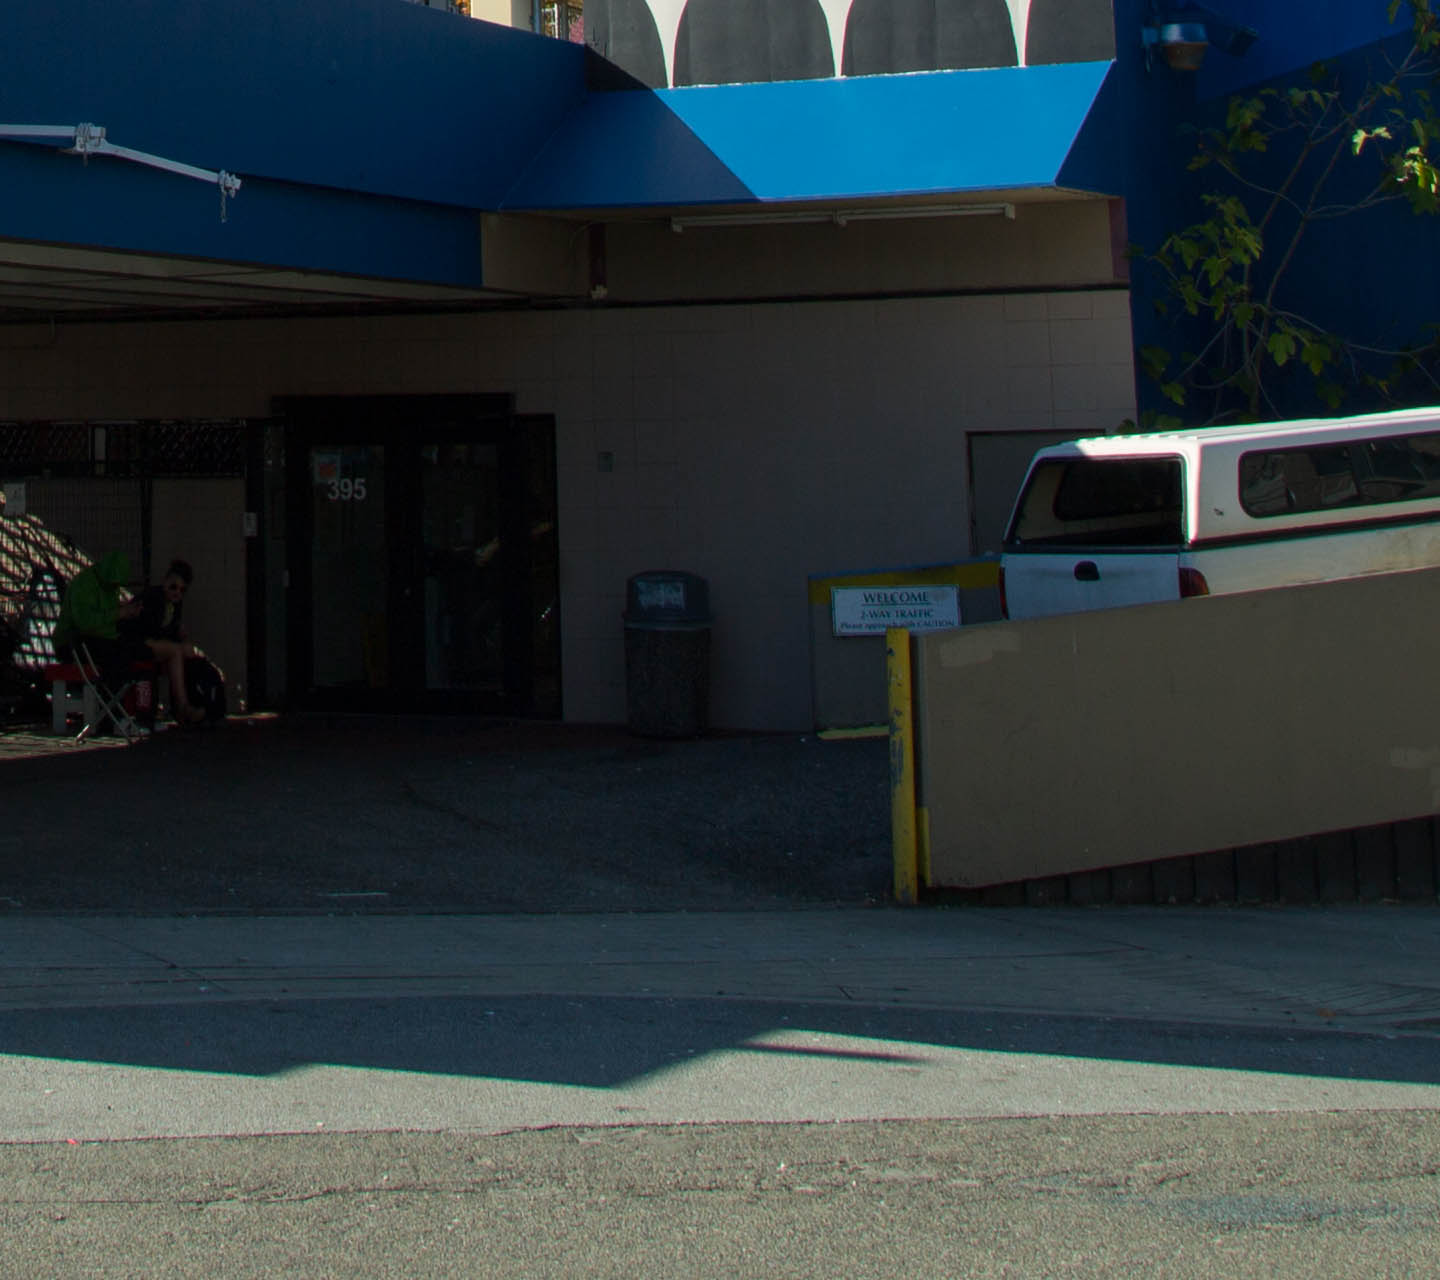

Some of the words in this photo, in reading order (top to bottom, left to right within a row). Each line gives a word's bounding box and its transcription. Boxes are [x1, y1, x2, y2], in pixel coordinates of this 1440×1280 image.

[327, 478, 367, 500] 395
[862, 591, 928, 603] WELCOME
[861, 608, 891, 620] 2-WAY
[895, 607, 934, 618] TRAFFIC
